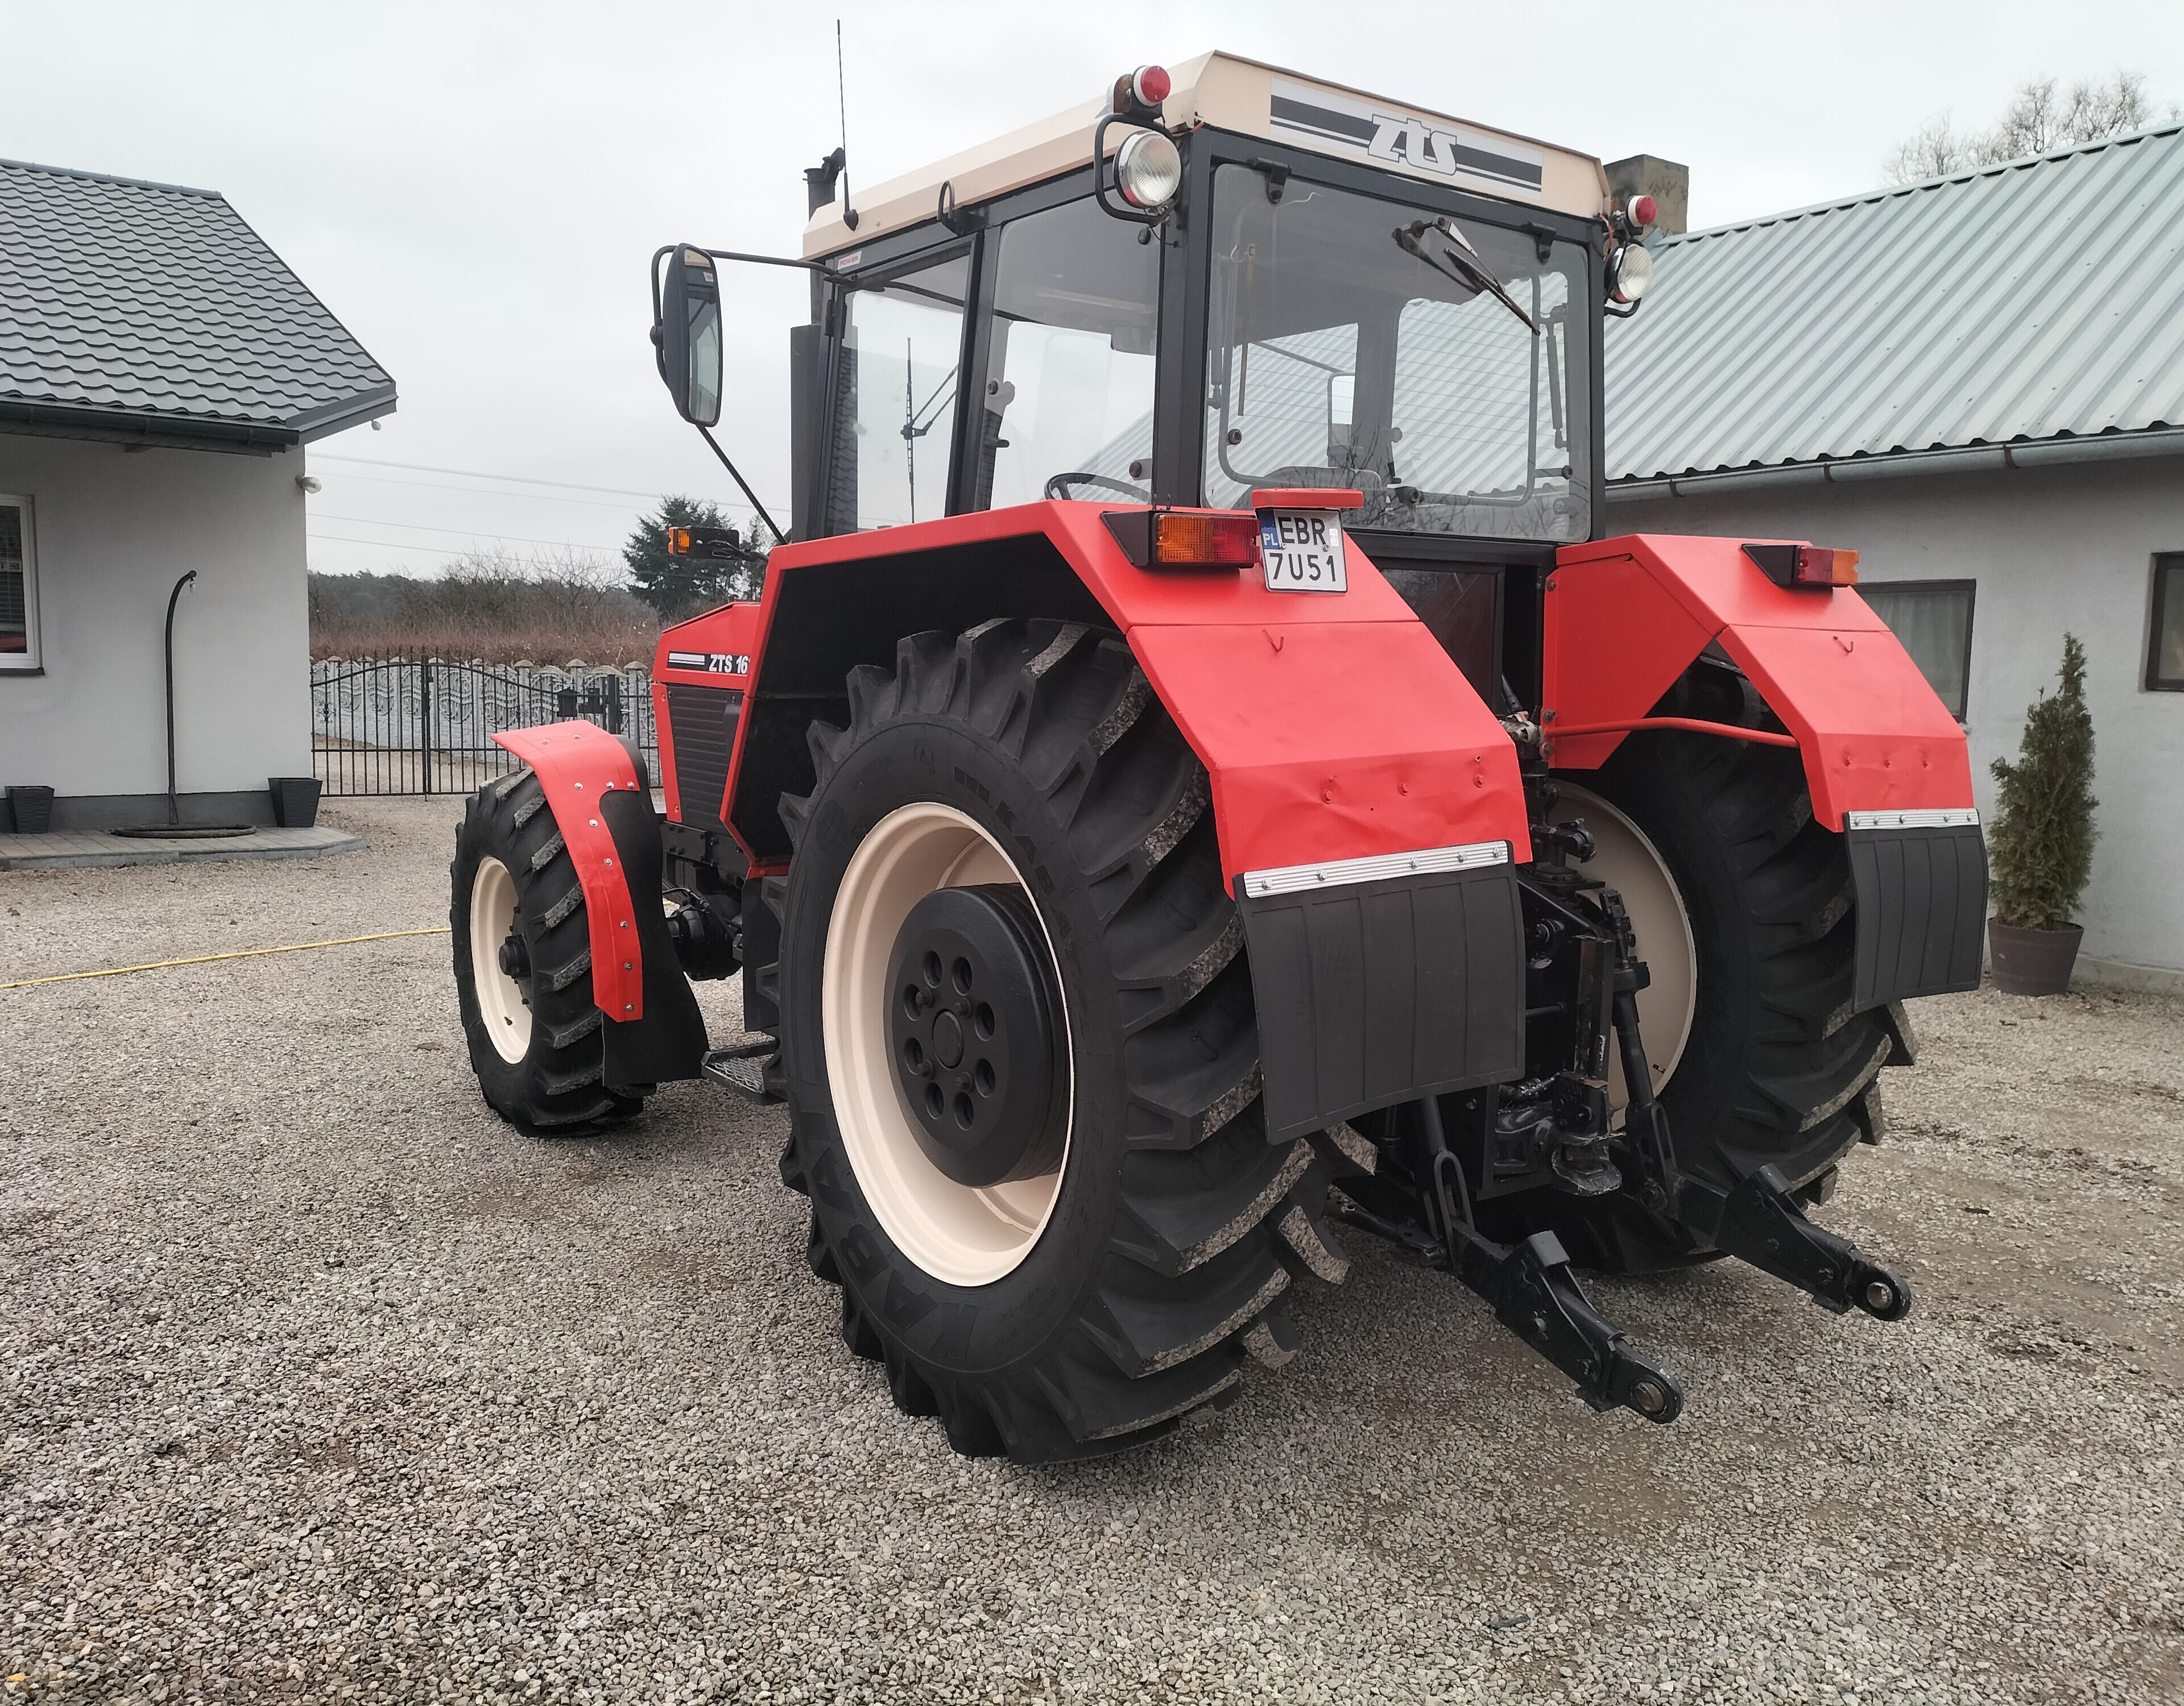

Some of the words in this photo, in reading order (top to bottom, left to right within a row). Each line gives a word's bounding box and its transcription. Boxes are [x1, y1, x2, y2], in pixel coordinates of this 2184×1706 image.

[1263, 533, 1278, 545] PL
[1278, 517, 1326, 545] EBR
[1269, 553, 1335, 581] 7U51
[709, 654, 733, 673] ZTS
[736, 655, 751, 674] 16
